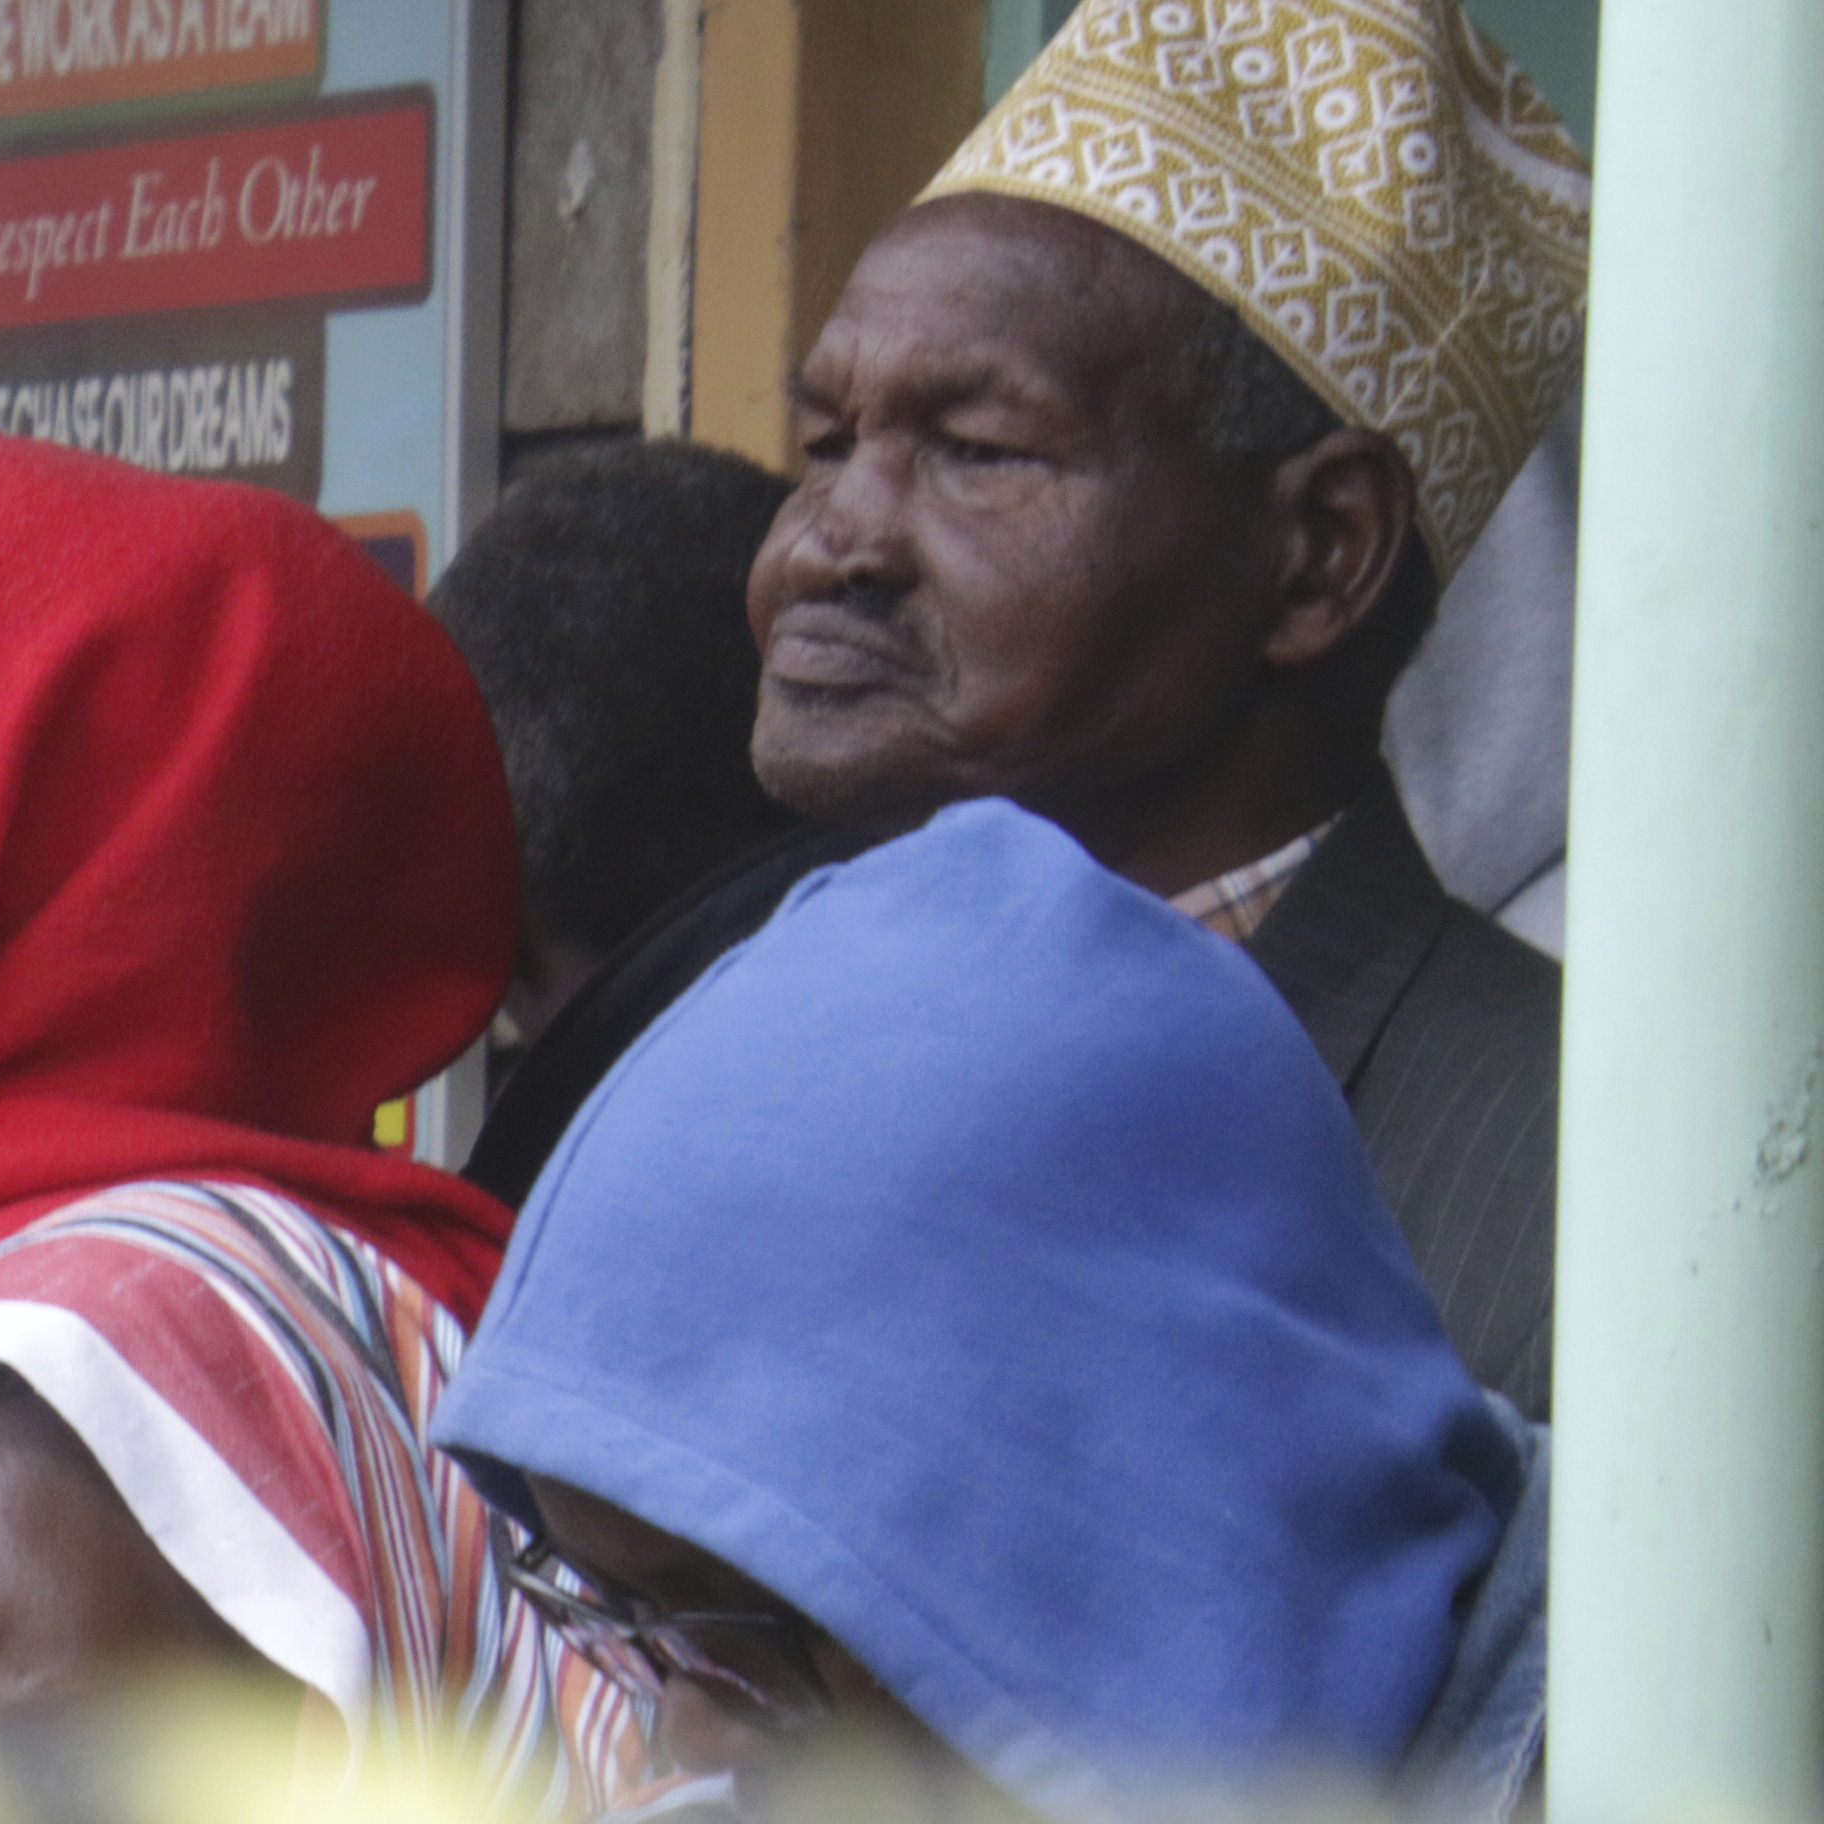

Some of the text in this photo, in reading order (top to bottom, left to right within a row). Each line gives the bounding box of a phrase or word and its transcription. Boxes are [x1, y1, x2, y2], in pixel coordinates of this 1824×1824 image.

[120, 155, 227, 260] Each
[237, 144, 378, 247] Other
[103, 369, 166, 472] OUR
[167, 356, 295, 473] DREAMS
